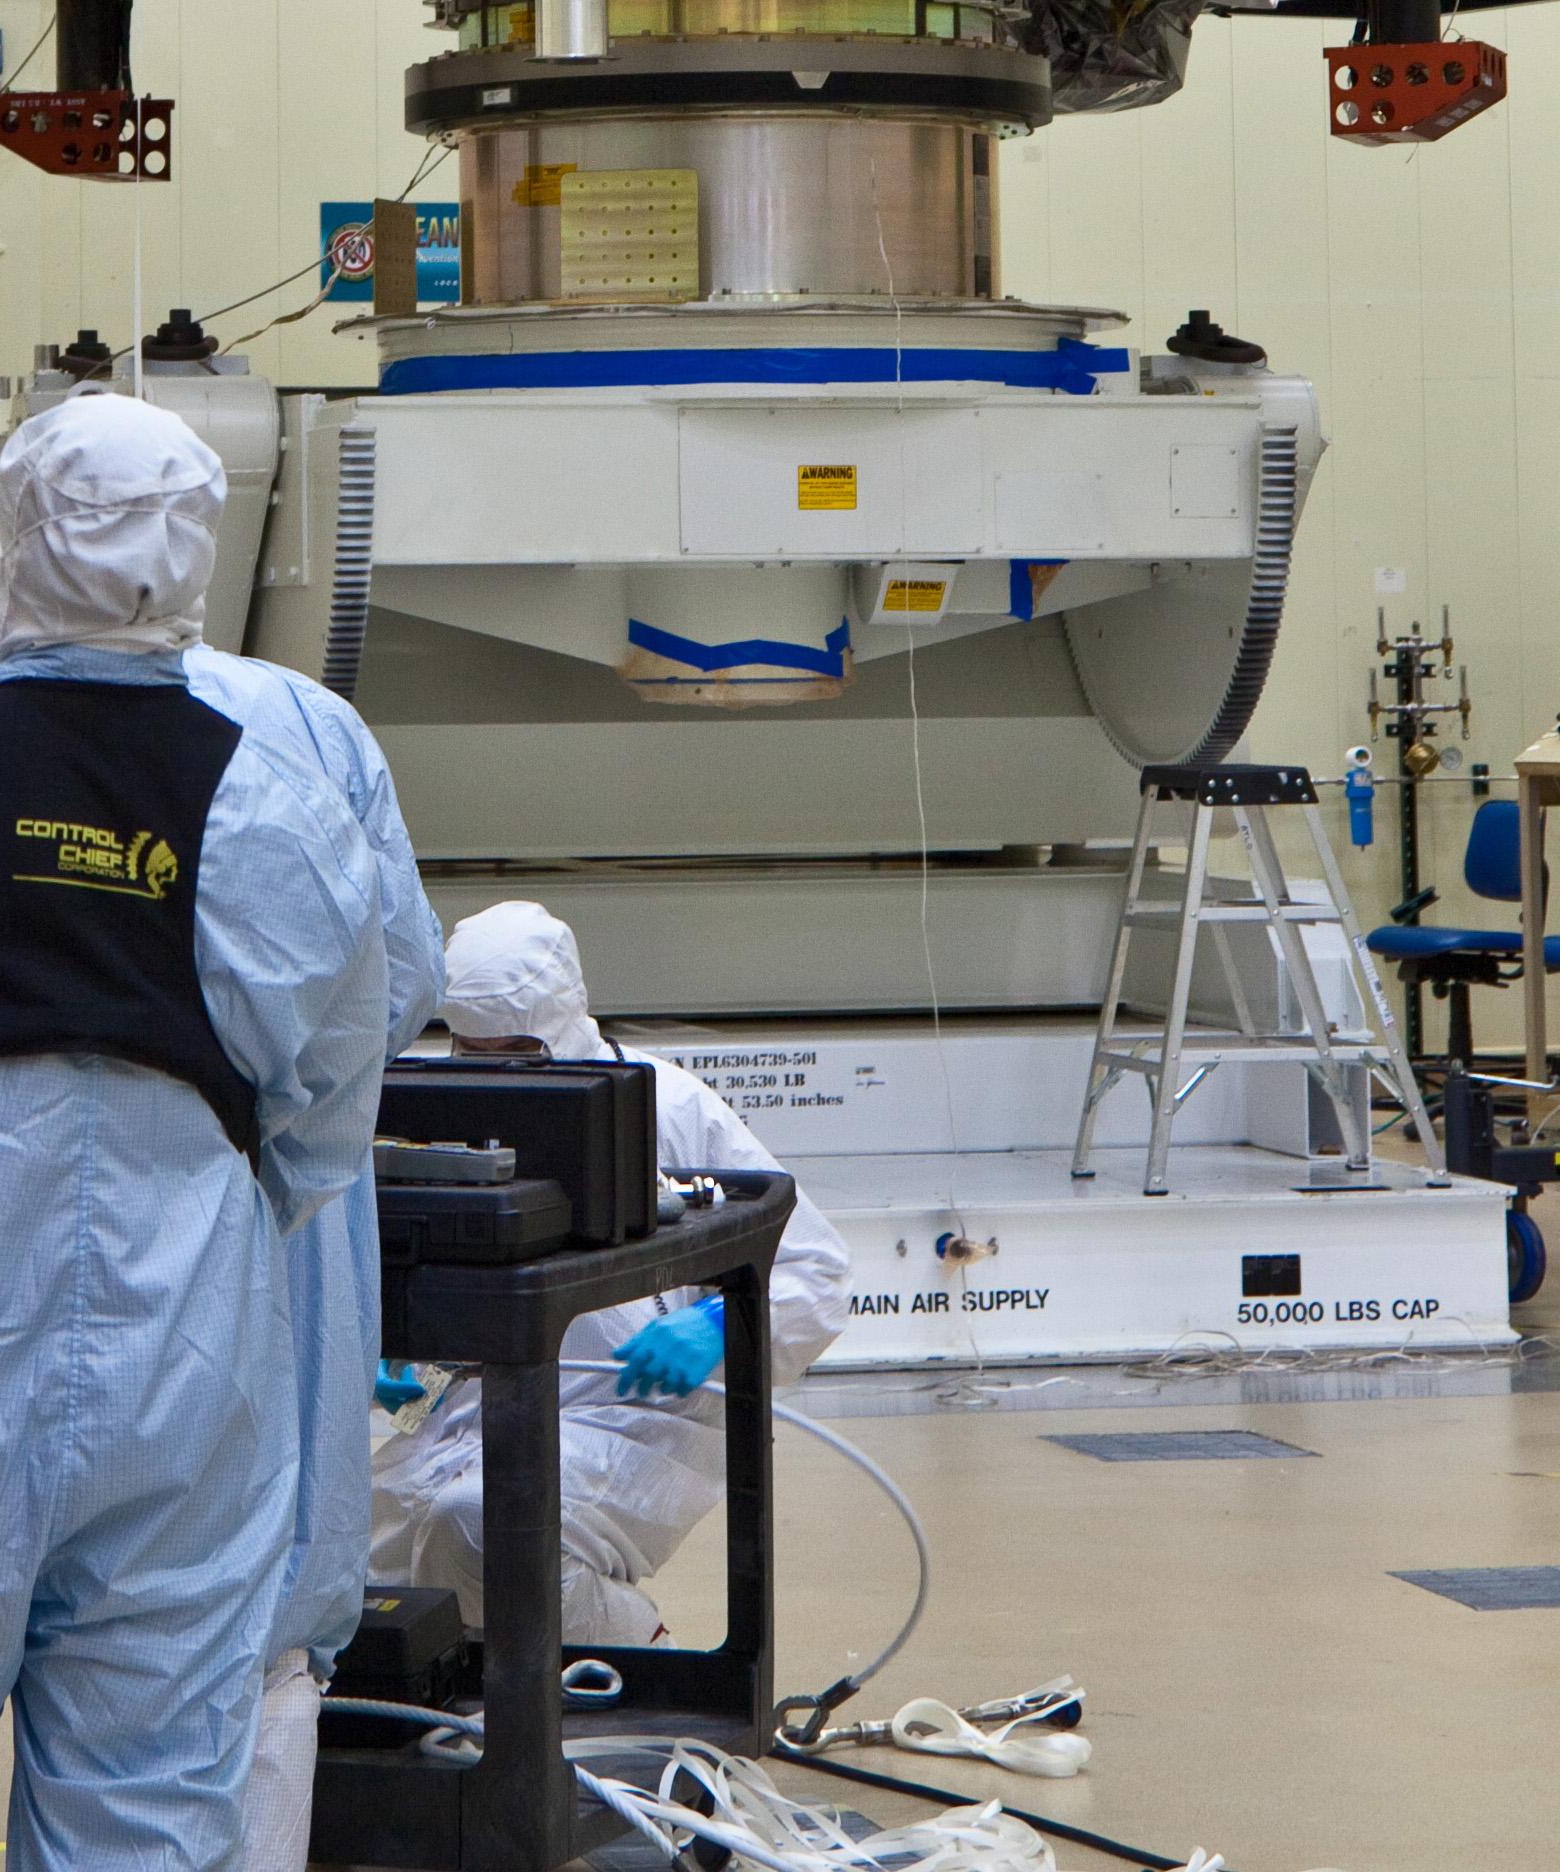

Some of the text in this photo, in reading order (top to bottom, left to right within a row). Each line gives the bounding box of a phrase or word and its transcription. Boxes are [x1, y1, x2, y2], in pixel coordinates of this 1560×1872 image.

[416, 217, 459, 247] EAN
[16, 819, 123, 849] CONTROL
[59, 844, 123, 868] CHIEF
[58, 862, 124, 879] CORPORATION
[692, 1052, 817, 1070] EPL6304739-501
[726, 1075, 777, 1089] 30,530
[784, 1073, 806, 1087] LB
[742, 1094, 783, 1109] 53.50
[791, 1093, 844, 1107] inches
[849, 1288, 1049, 1315] MAIN AIR SUPPLY
[1238, 1299, 1440, 1326] 50,000 LBS CAP
